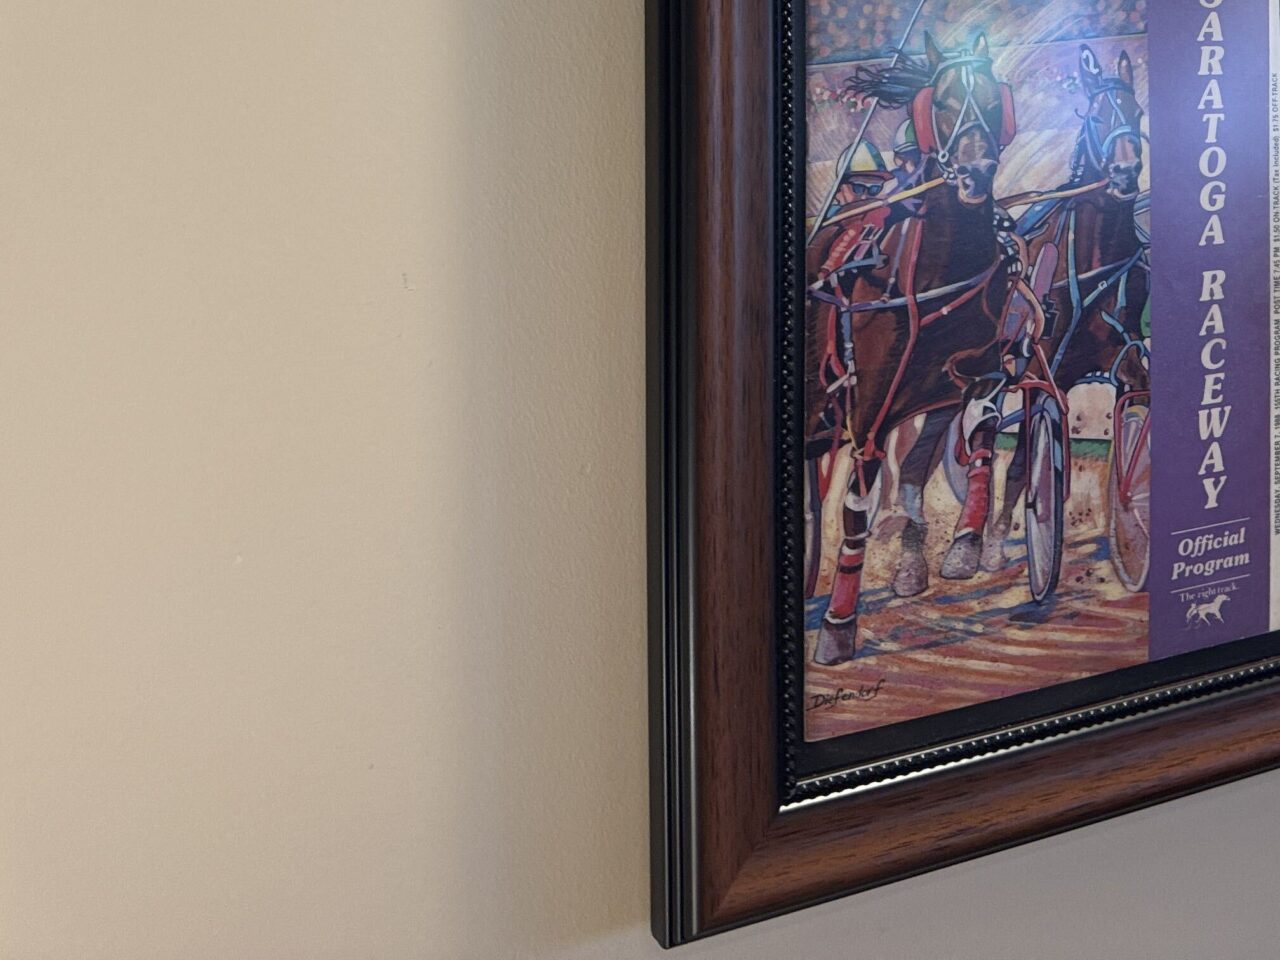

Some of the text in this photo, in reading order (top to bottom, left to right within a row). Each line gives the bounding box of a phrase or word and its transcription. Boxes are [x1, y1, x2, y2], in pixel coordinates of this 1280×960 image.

[1273, 246, 1280, 258] PM
[1198, 269, 1232, 509] RACEWAY
[1178, 526, 1246, 558] Official
[1171, 552, 1250, 580] Program
[1180, 586, 1216, 602] The right
